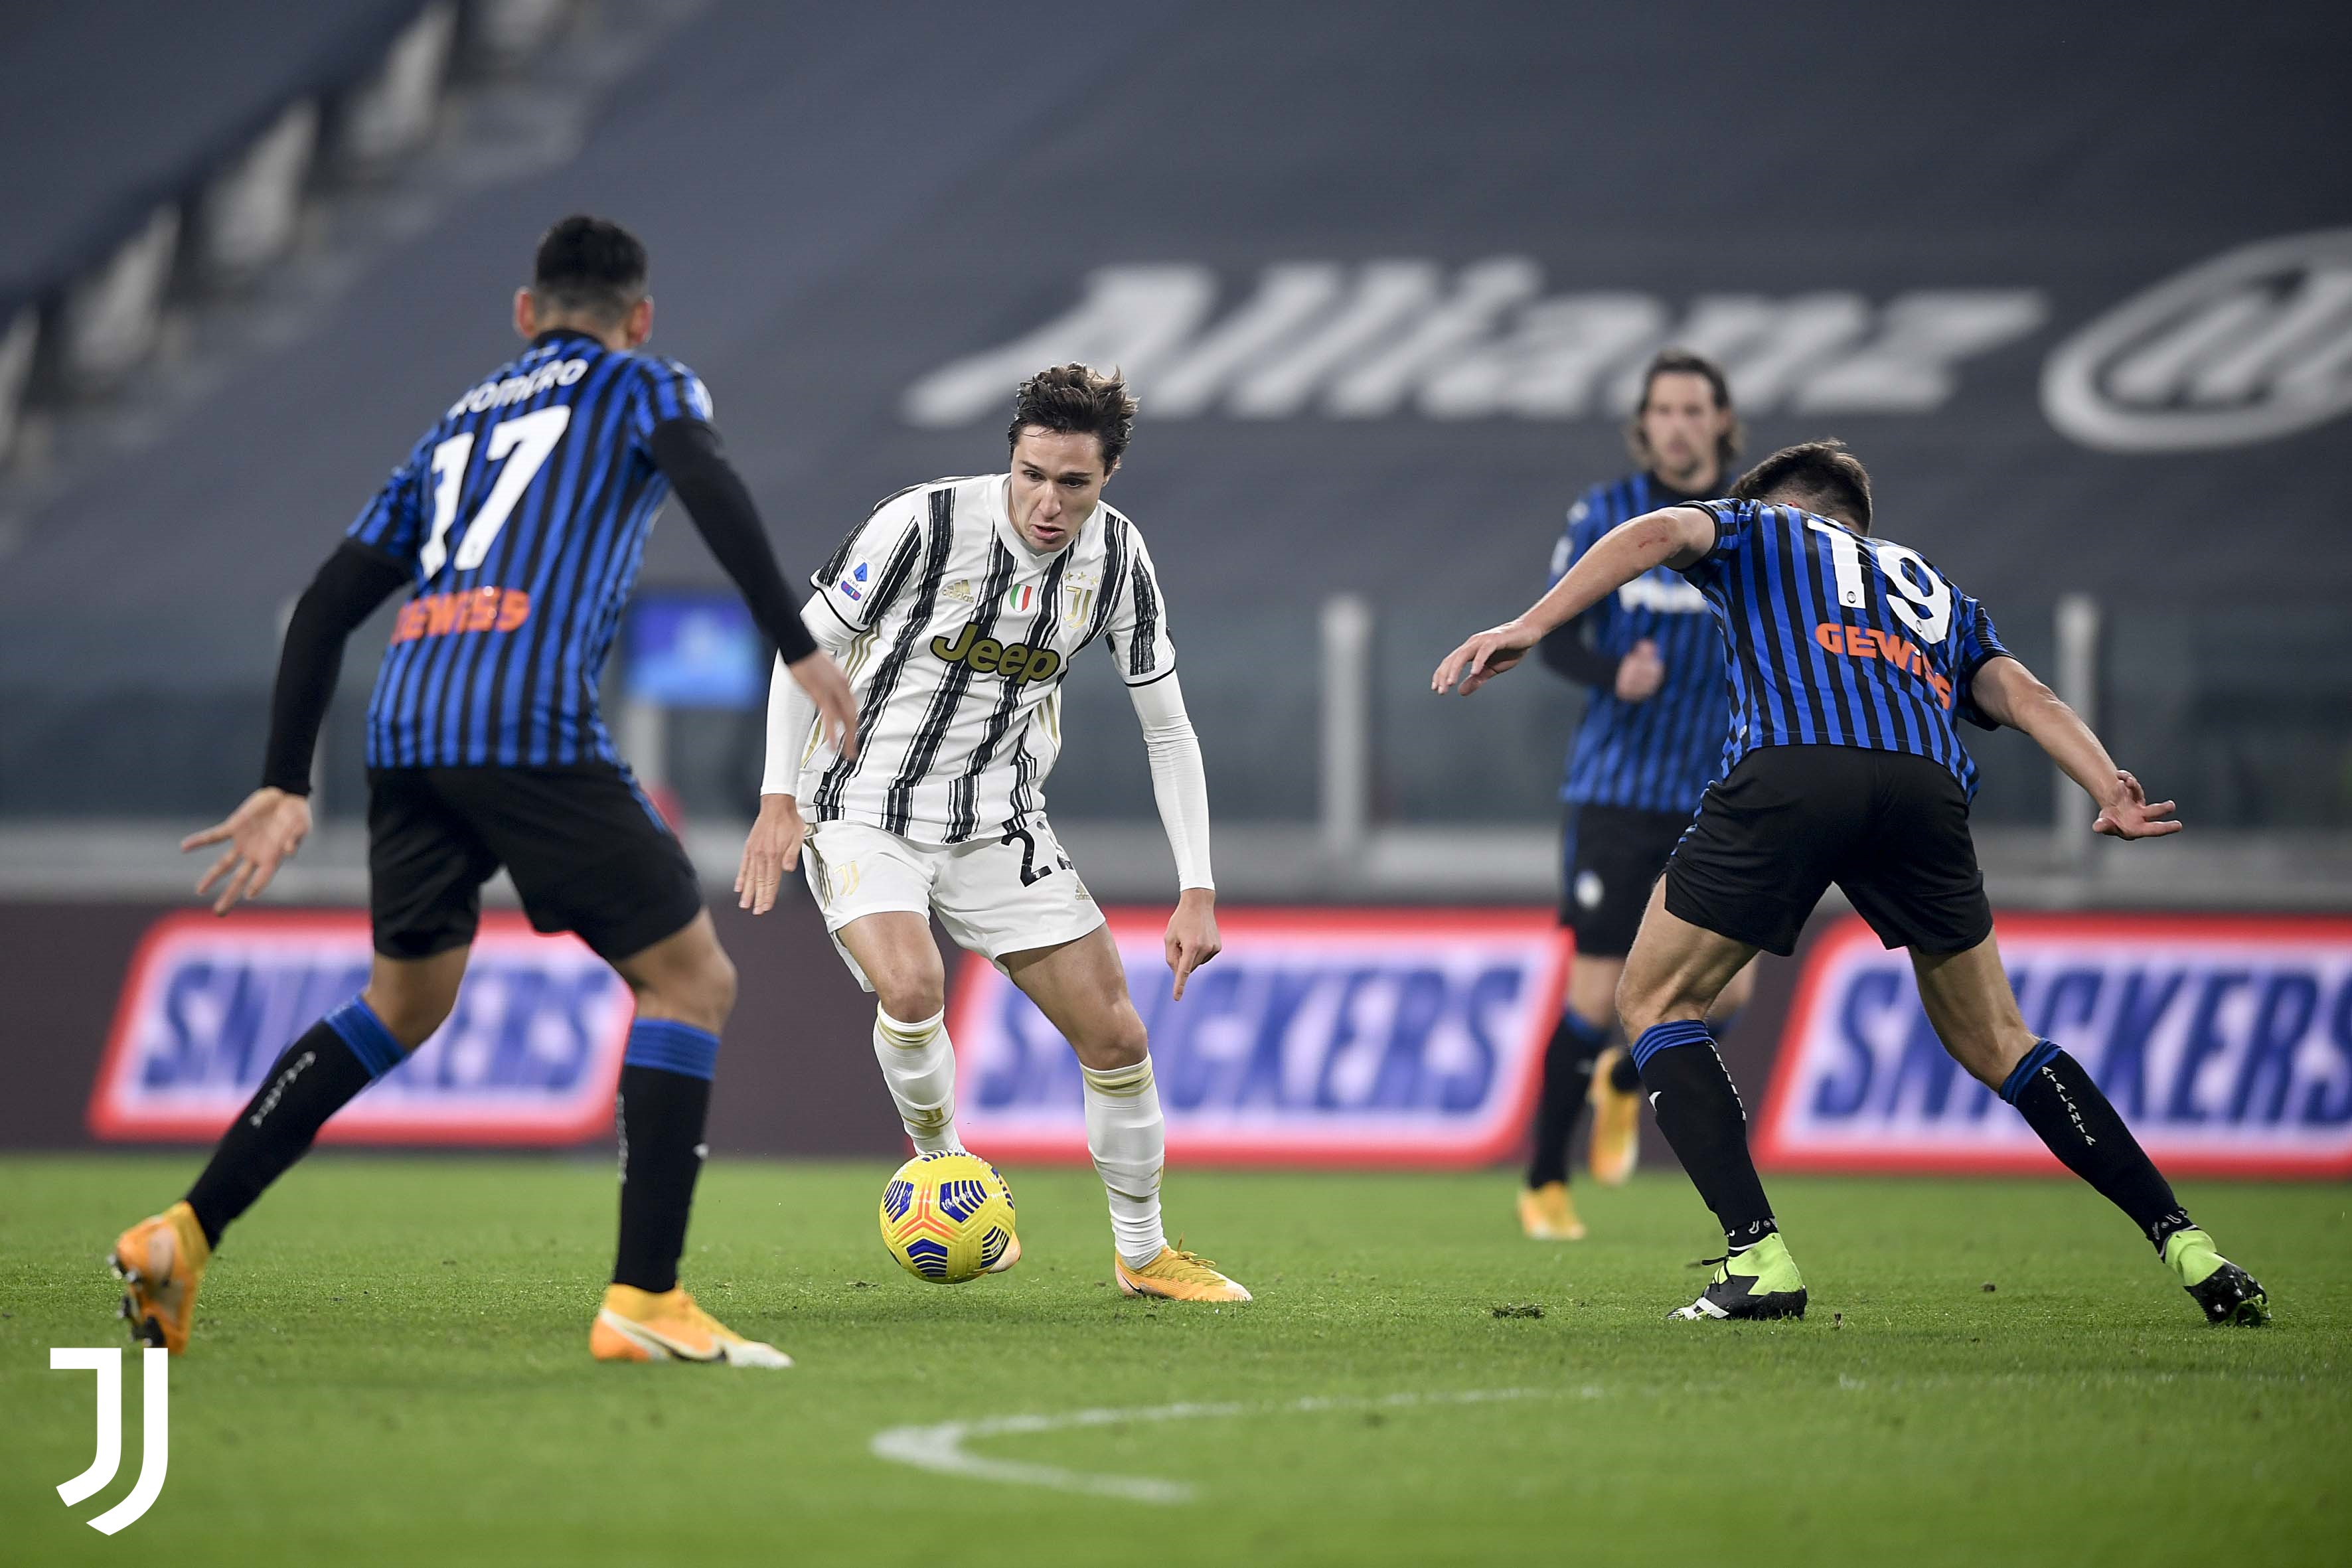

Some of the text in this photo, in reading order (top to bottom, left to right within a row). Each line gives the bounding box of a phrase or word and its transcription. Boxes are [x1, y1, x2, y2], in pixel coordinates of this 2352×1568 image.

[900, 258, 2051, 428] Allianz
[420, 405, 571, 580] 17
[941, 588, 975, 604] adidas
[1807, 518, 1950, 645] 19
[929, 621, 1061, 688] Jeep
[141, 959, 622, 1091] SNIERS
[971, 963, 1526, 1115] SICKERS
[2041, 1066, 2096, 1146] ATALANTA
